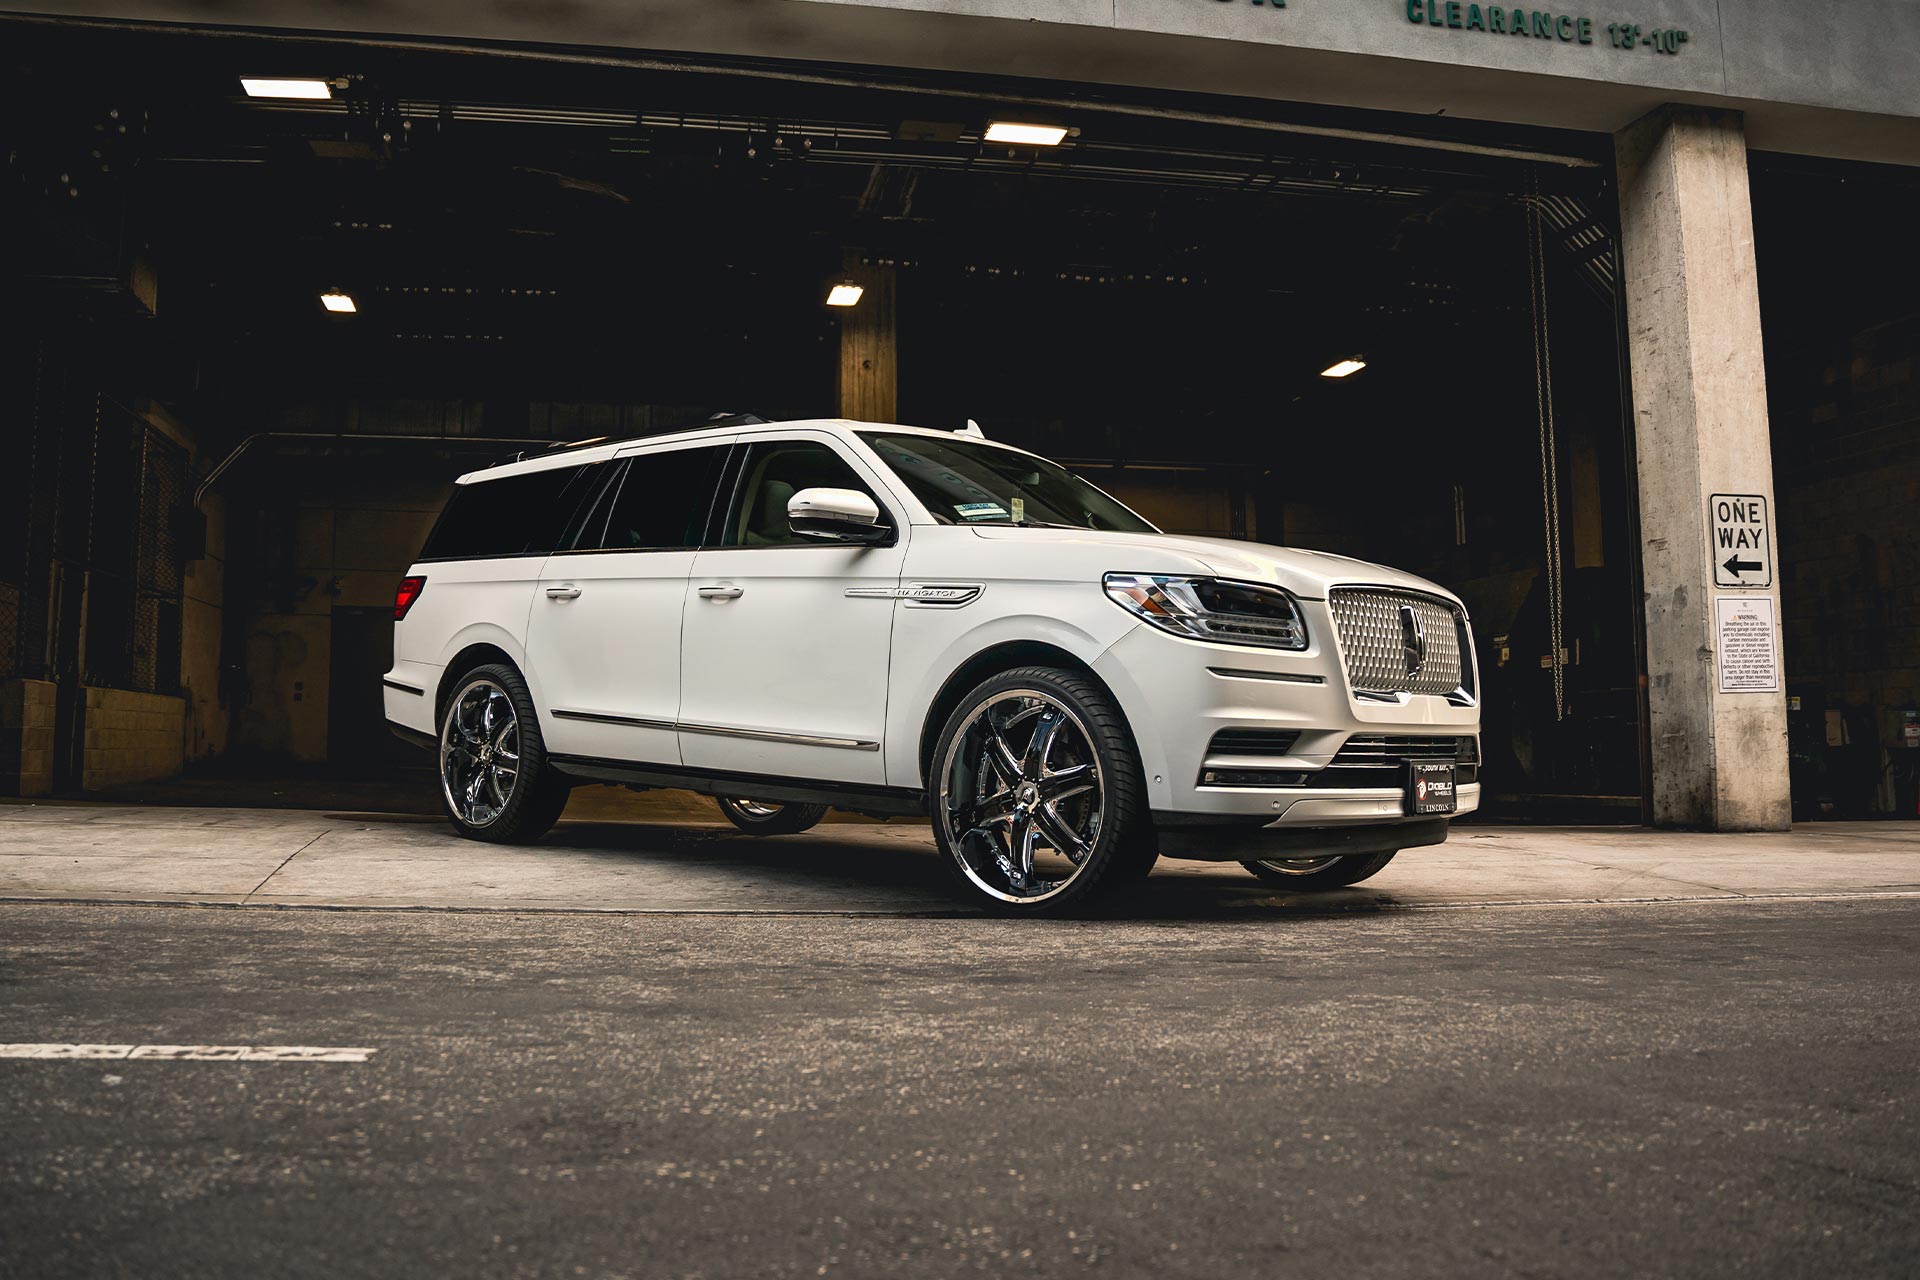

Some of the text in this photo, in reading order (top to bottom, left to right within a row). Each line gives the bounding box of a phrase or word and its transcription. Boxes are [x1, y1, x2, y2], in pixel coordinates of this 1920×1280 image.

[1407, 0, 1593, 44] CLEARANCE
[1717, 501, 1761, 524] ONE
[1717, 527, 1763, 549] WAY
[1428, 782, 1452, 791] DIABLO
[1426, 804, 1449, 812] LINCOLN
